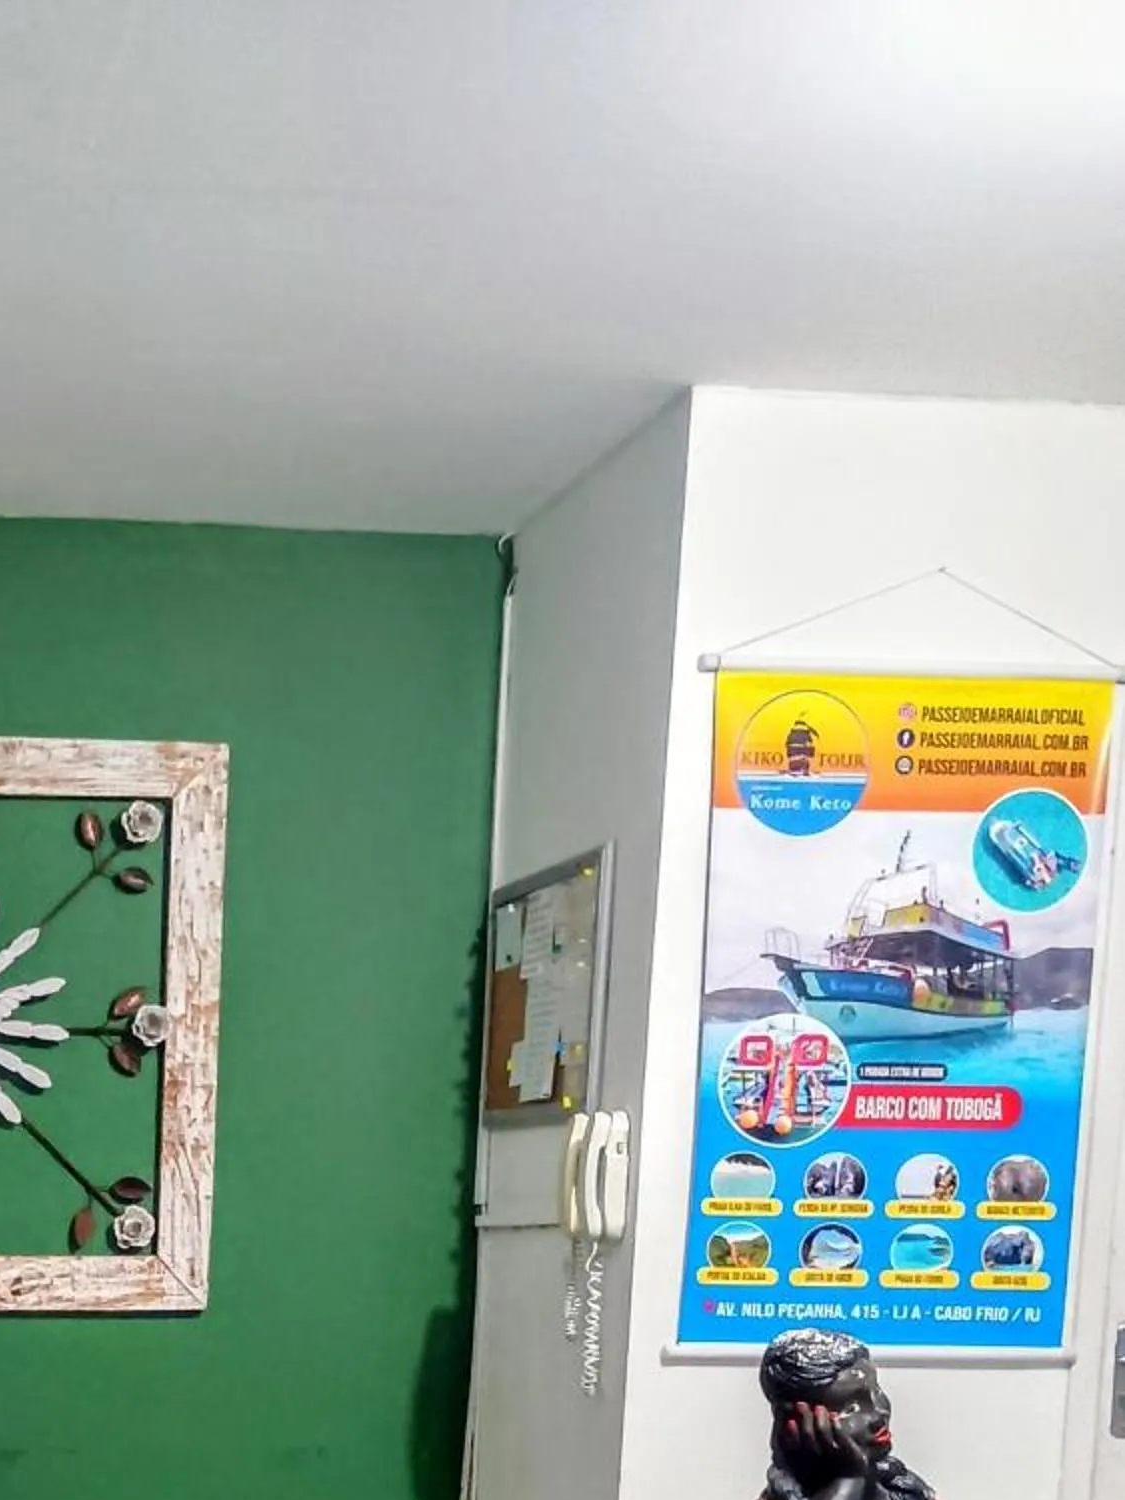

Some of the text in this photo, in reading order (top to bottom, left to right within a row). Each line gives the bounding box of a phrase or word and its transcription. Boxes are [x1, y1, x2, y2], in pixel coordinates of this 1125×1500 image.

[740, 751, 866, 768] KIKO TOUR
[750, 793, 802, 810] Kome
[854, 1092, 1004, 1122] BARCO COM TOBOGÃ
[716, 1301, 738, 1318] AV.
[741, 1301, 775, 1319] NILO
[851, 1303, 880, 1320] 415
[934, 1305, 973, 1322] CABO
[976, 1306, 1009, 1322] FRIO
